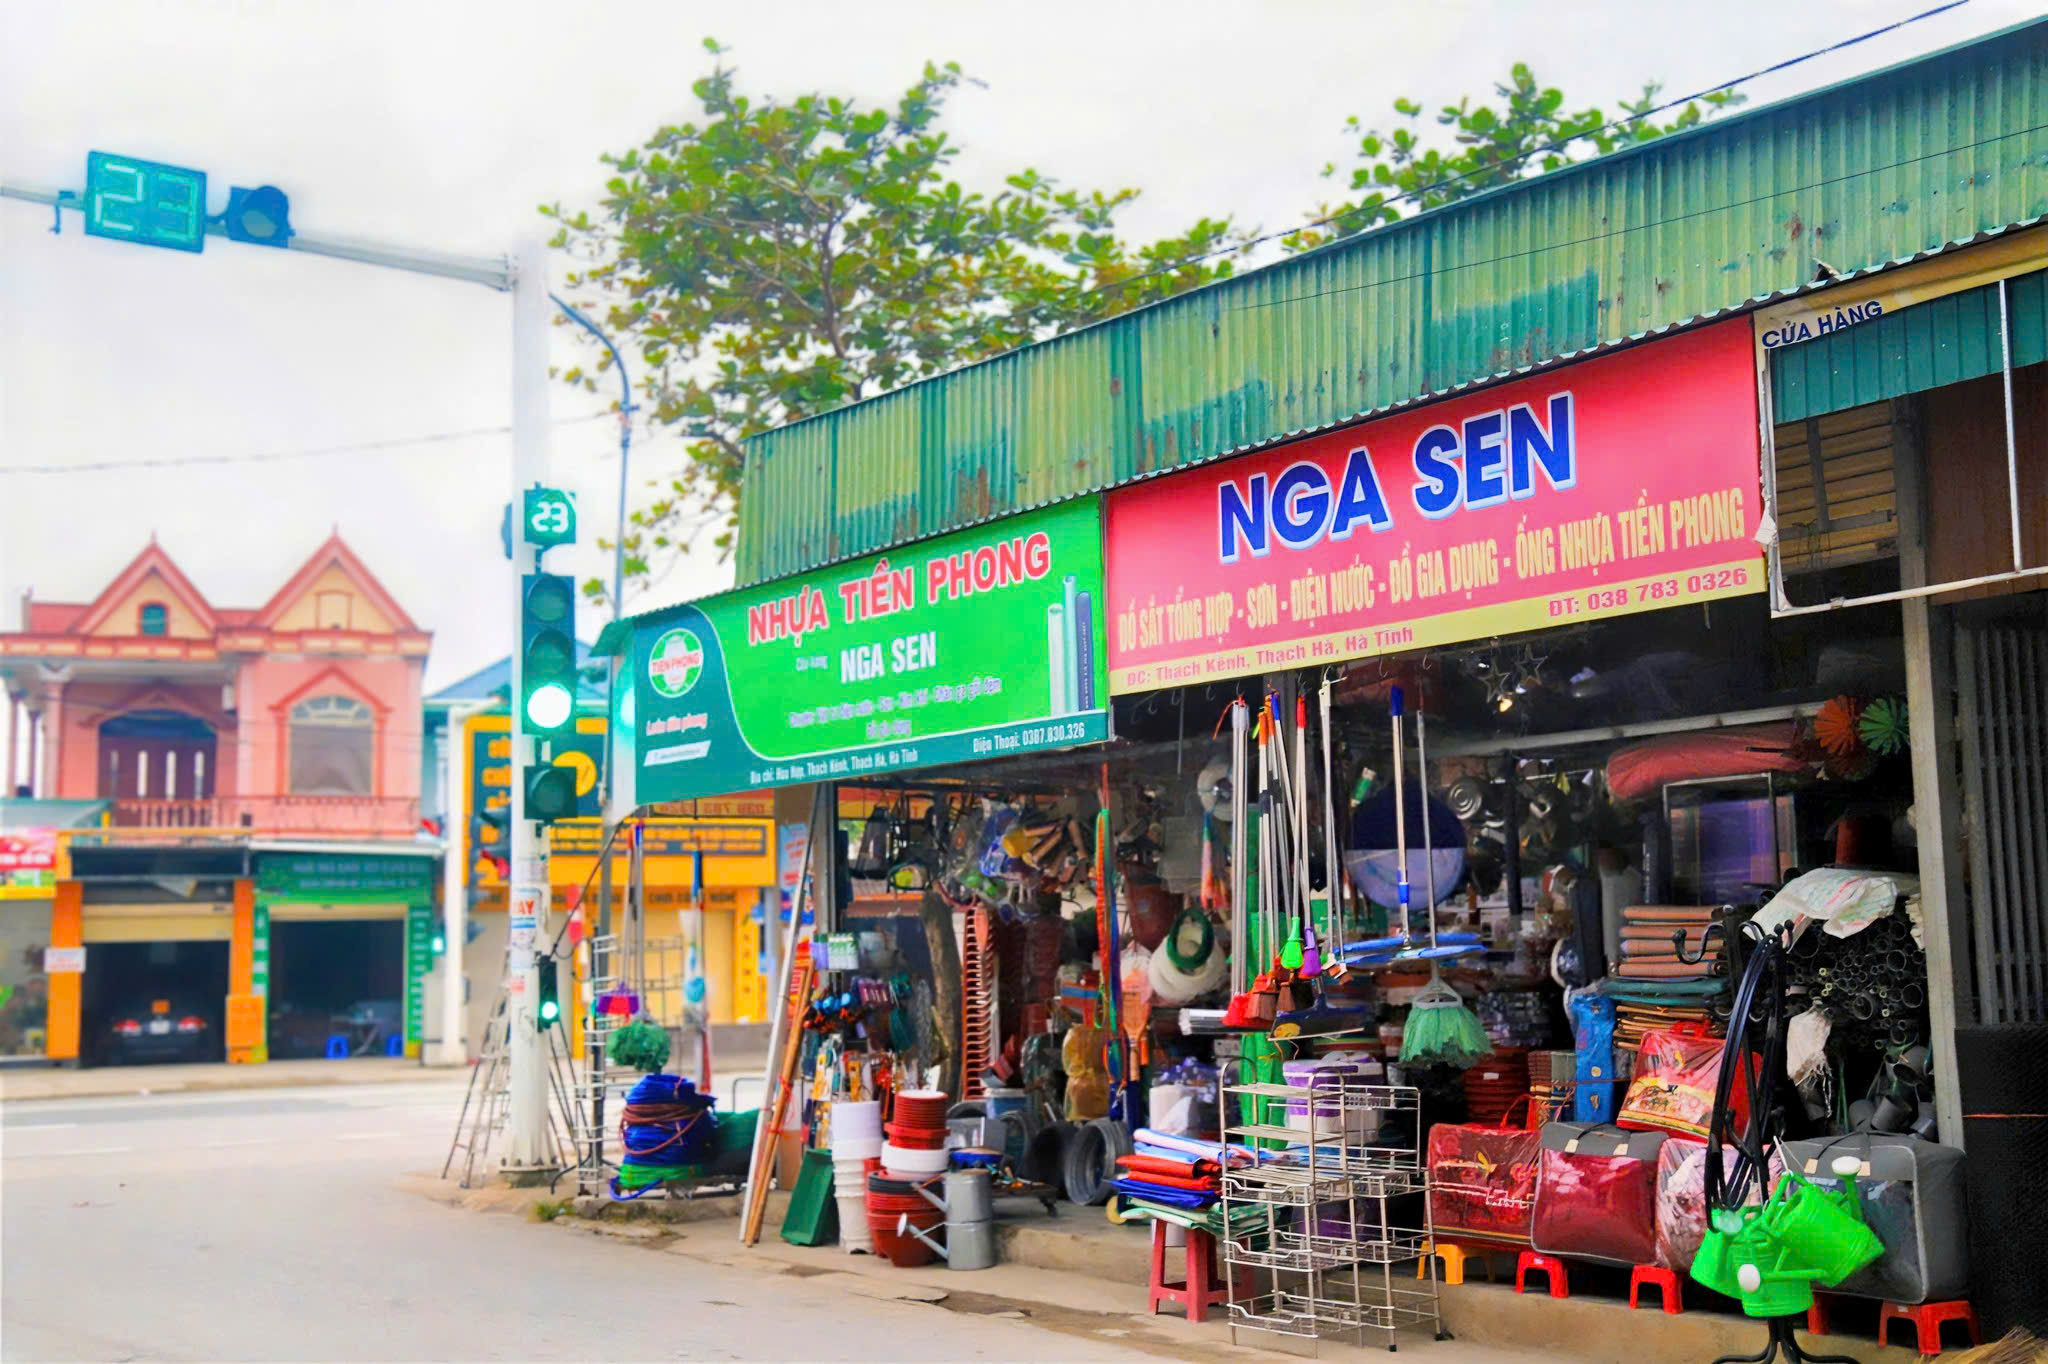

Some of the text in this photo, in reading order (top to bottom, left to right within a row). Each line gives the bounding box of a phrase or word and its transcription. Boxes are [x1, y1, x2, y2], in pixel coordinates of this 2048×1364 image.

[94, 162, 198, 241] 23
[1762, 300, 1883, 348] CỬA HÀNG
[1218, 391, 1577, 564] NGA SEN
[531, 501, 569, 533] 23
[1247, 582, 1278, 629] SƠN
[1290, 567, 1328, 628] ĐIỆN
[1330, 554, 1375, 614] NƯỚC
[1389, 541, 1412, 604] ĐỒ
[1416, 550, 1447, 598] GIA
[1449, 539, 1499, 600] DỤNG
[1515, 514, 1555, 579] ỐNG
[1559, 511, 1615, 576] NHỰA
[1617, 489, 1665, 560] TIỀN
[1669, 487, 1745, 550] PHONG
[748, 532, 1050, 648] NHỰA TIỀN PHONG
[1549, 568, 1748, 617] ĐT: 038 783 0326
[841, 631, 937, 684] NGA SEN
[1345, 634, 1368, 652] Hà
